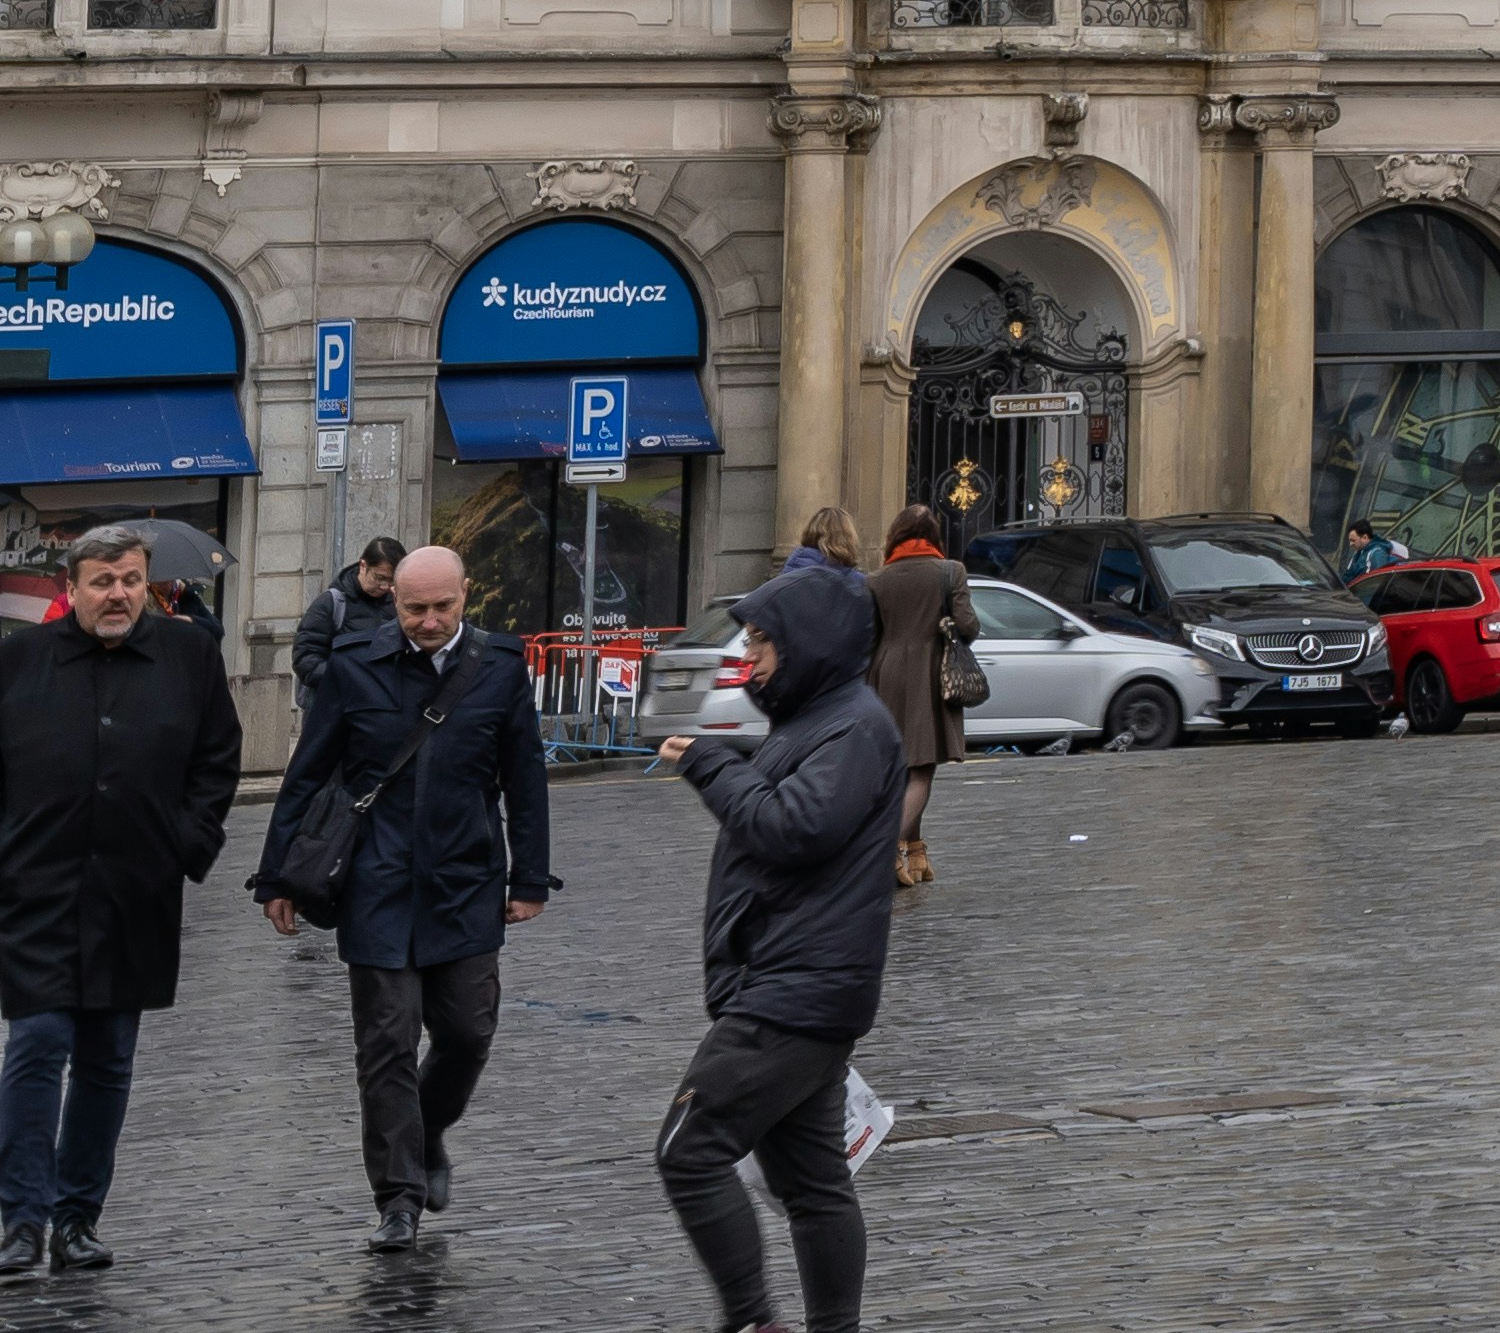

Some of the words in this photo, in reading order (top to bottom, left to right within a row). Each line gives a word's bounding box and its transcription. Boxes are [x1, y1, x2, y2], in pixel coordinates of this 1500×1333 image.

[513, 280, 667, 308] kudyznudy.cz
[513, 306, 594, 320] CzechTourism
[323, 334, 345, 391] P
[582, 388, 616, 436] P
